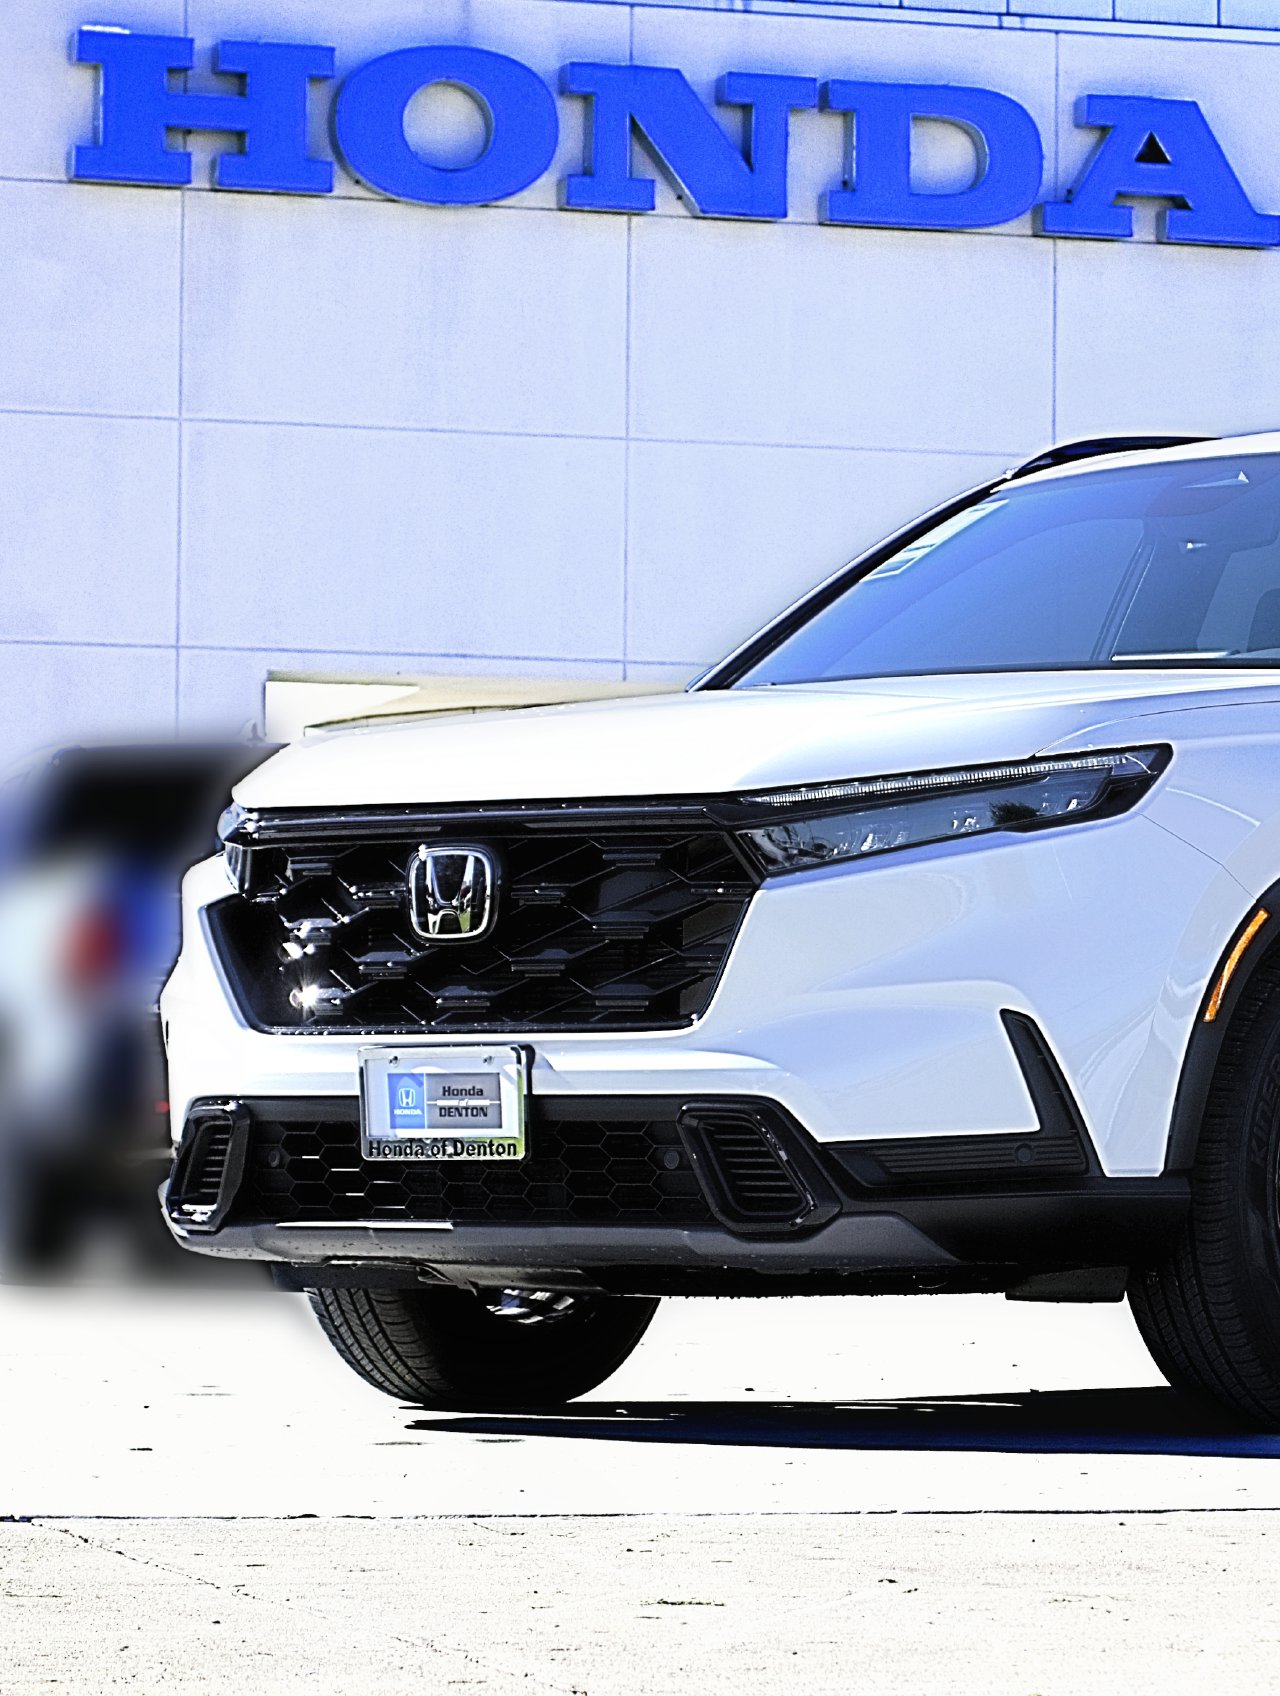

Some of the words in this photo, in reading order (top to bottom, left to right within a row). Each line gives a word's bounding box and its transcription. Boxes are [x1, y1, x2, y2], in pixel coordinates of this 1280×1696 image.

[442, 1086, 484, 1096] Honda
[393, 1108, 422, 1116] HONDA
[439, 1107, 488, 1117] DENTON
[367, 1139, 425, 1158] Honda
[430, 1138, 450, 1157] of
[453, 1138, 517, 1158] Denton
